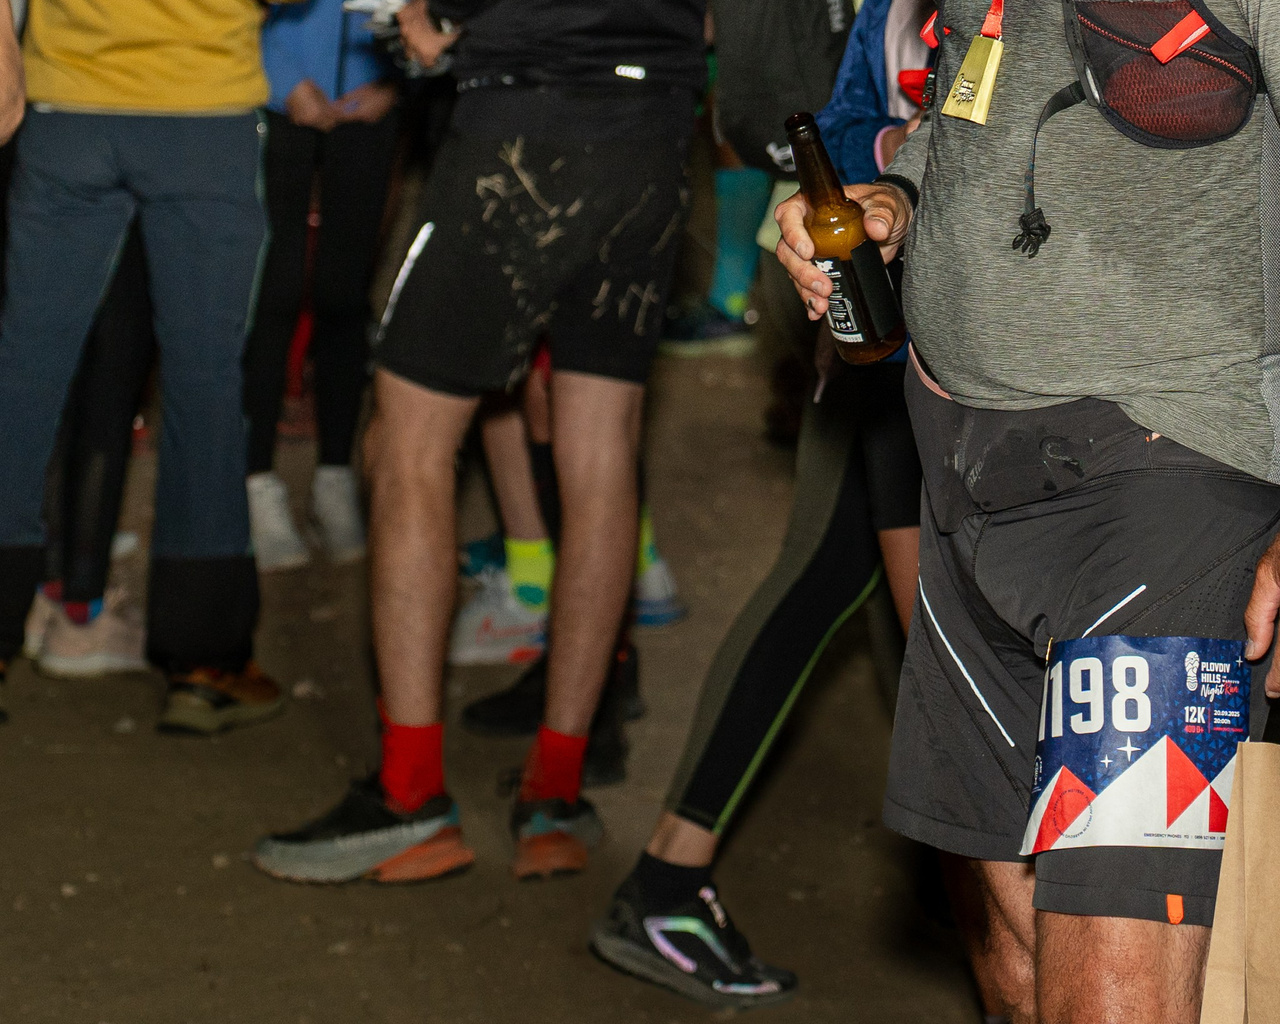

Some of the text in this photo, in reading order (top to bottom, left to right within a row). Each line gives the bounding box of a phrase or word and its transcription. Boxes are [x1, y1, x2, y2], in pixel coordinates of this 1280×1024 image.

[1201, 662, 1231, 673] PLOVDIV
[1201, 673, 1221, 683] HILLS
[1200, 682, 1239, 702] Night Run
[1184, 706, 1206, 724] 12K
